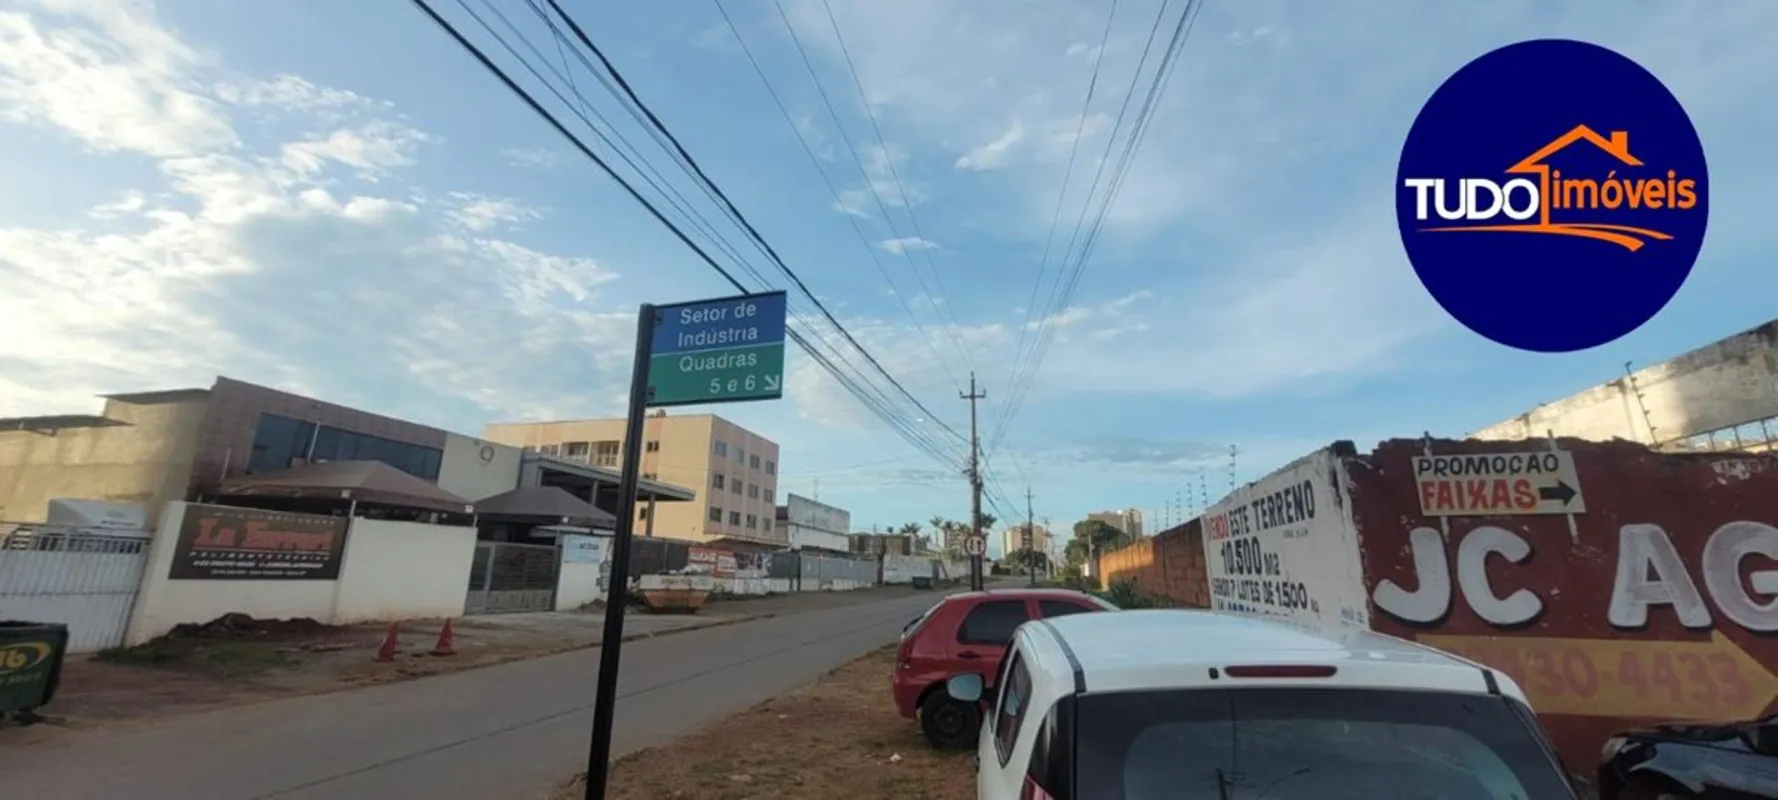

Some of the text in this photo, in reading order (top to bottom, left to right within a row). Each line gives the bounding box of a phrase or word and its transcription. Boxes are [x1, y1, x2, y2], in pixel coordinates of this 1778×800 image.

[680, 302, 757, 325] Setor de
[678, 327, 758, 347] Indústria
[679, 353, 757, 372] Quadras
[710, 375, 756, 394] 5 e 6
[1421, 478, 1538, 511] FAIXAS
[1229, 504, 1250, 537] ESTE
[1252, 479, 1316, 531] TERRENO
[1372, 526, 1545, 628] JC
[1237, 579, 1261, 602] LOTES
[1262, 580, 1275, 606] DE
